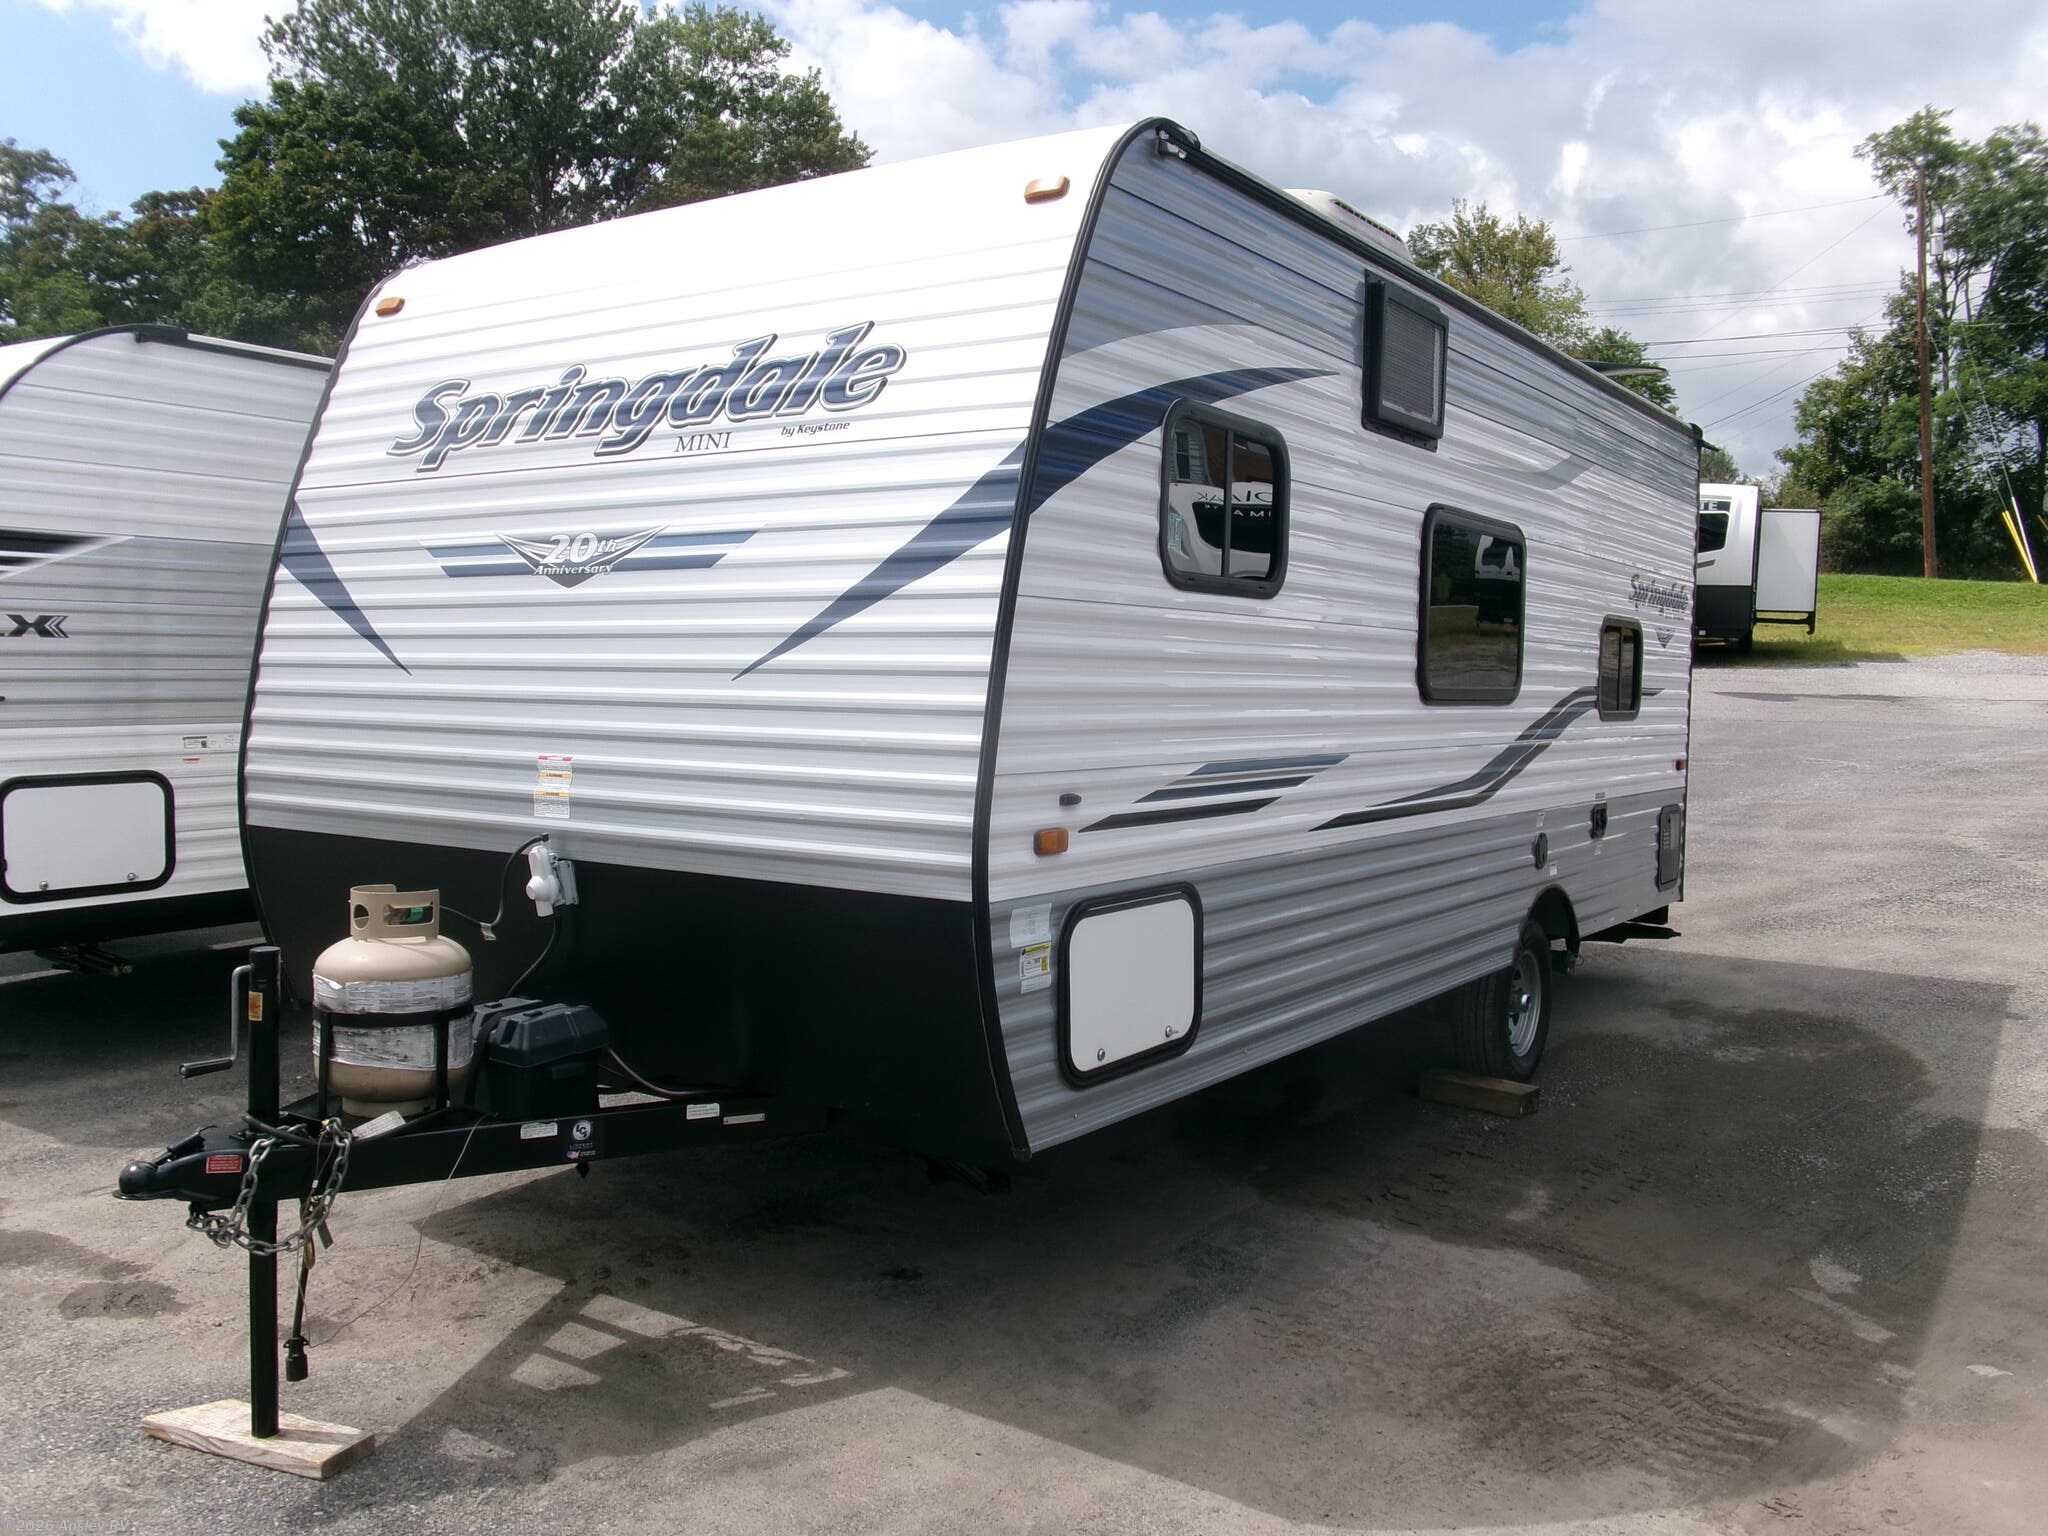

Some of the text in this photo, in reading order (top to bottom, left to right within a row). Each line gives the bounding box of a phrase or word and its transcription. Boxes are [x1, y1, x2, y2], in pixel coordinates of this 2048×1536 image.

[387, 320, 908, 472] Springdale
[781, 422, 850, 437] by Keystone
[674, 431, 732, 453] MINI
[540, 532, 617, 564] 20th
[534, 563, 614, 576] Anniversary
